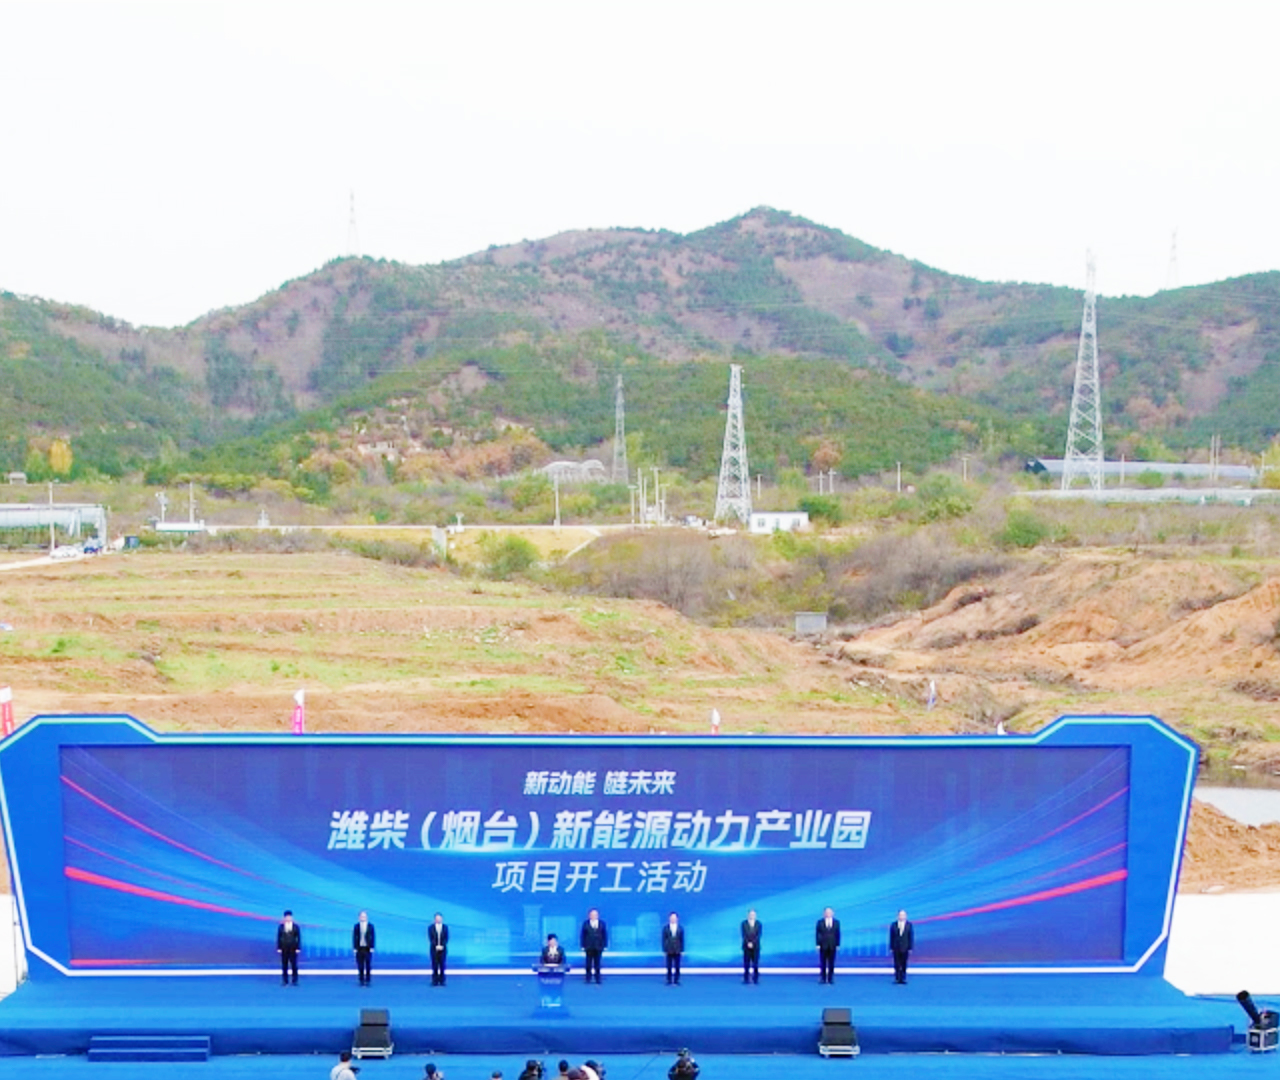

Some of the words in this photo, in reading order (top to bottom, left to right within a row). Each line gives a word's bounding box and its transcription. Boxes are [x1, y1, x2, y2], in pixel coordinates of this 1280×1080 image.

[523, 770, 597, 795] 新动能
[491, 859, 708, 893] 项目开工活动
